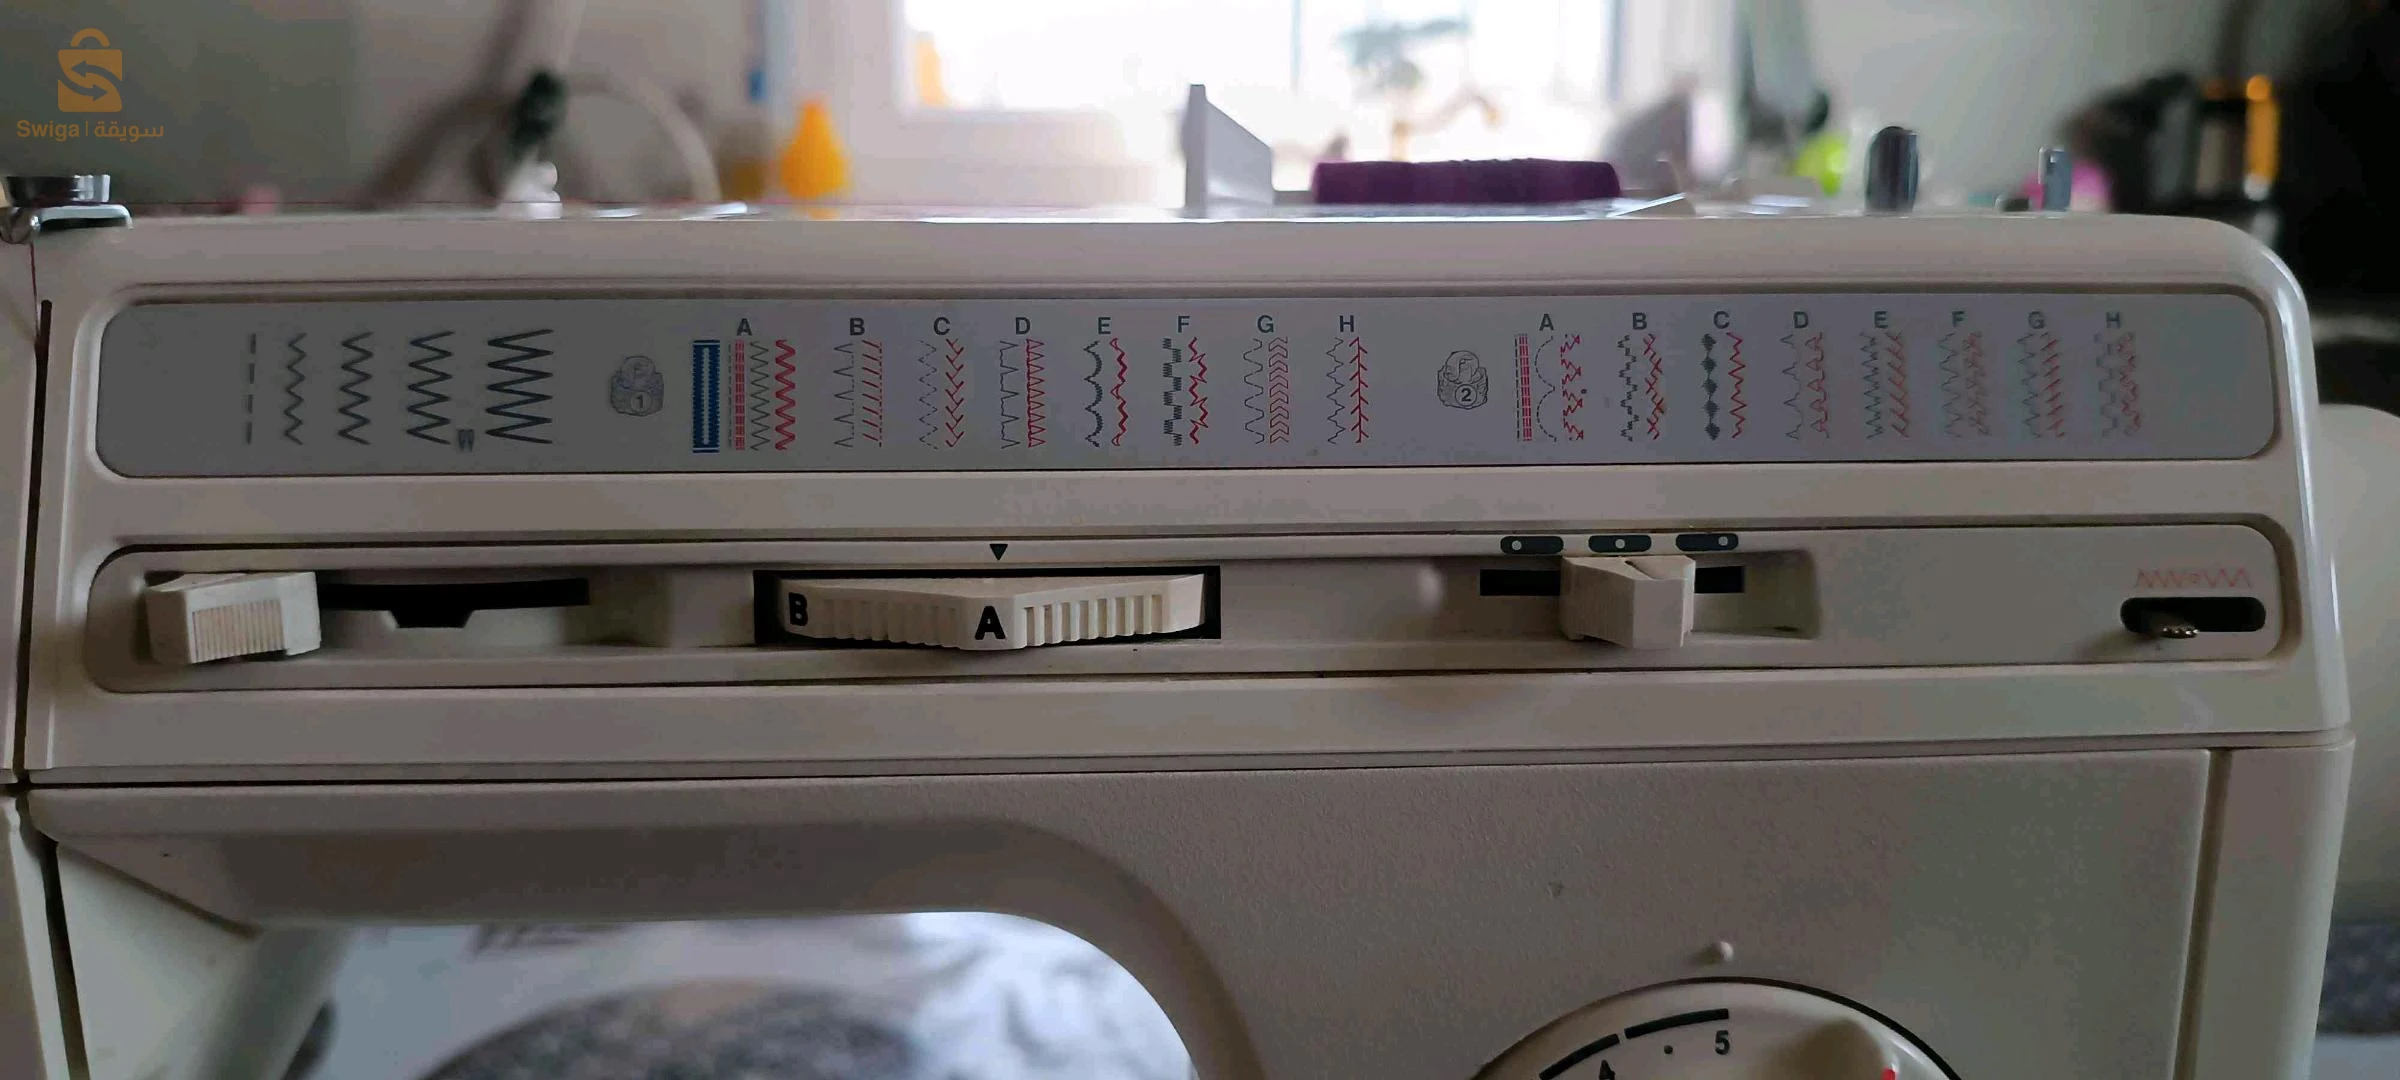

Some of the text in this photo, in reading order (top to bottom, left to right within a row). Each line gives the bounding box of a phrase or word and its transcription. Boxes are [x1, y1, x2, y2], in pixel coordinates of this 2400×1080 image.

[737, 317, 753, 336] A
[850, 318, 865, 335] B
[933, 317, 951, 336] C
[1015, 317, 1031, 335] D
[1098, 317, 1111, 334] E
[1177, 316, 1190, 333] F
[1257, 315, 1274, 333] G
[1339, 316, 1354, 333] H
[1539, 313, 1555, 331] A
[1632, 312, 1648, 330] B
[1713, 311, 1730, 329] C
[1793, 311, 1809, 329] D
[1874, 311, 1889, 328] E
[1952, 311, 1965, 328] F
[2028, 311, 2046, 329] G
[2106, 311, 2121, 328] H
[1461, 387, 1472, 402] 2
[788, 592, 808, 627] B
[974, 605, 1006, 640] A
[1715, 1029, 1730, 1055] 5
